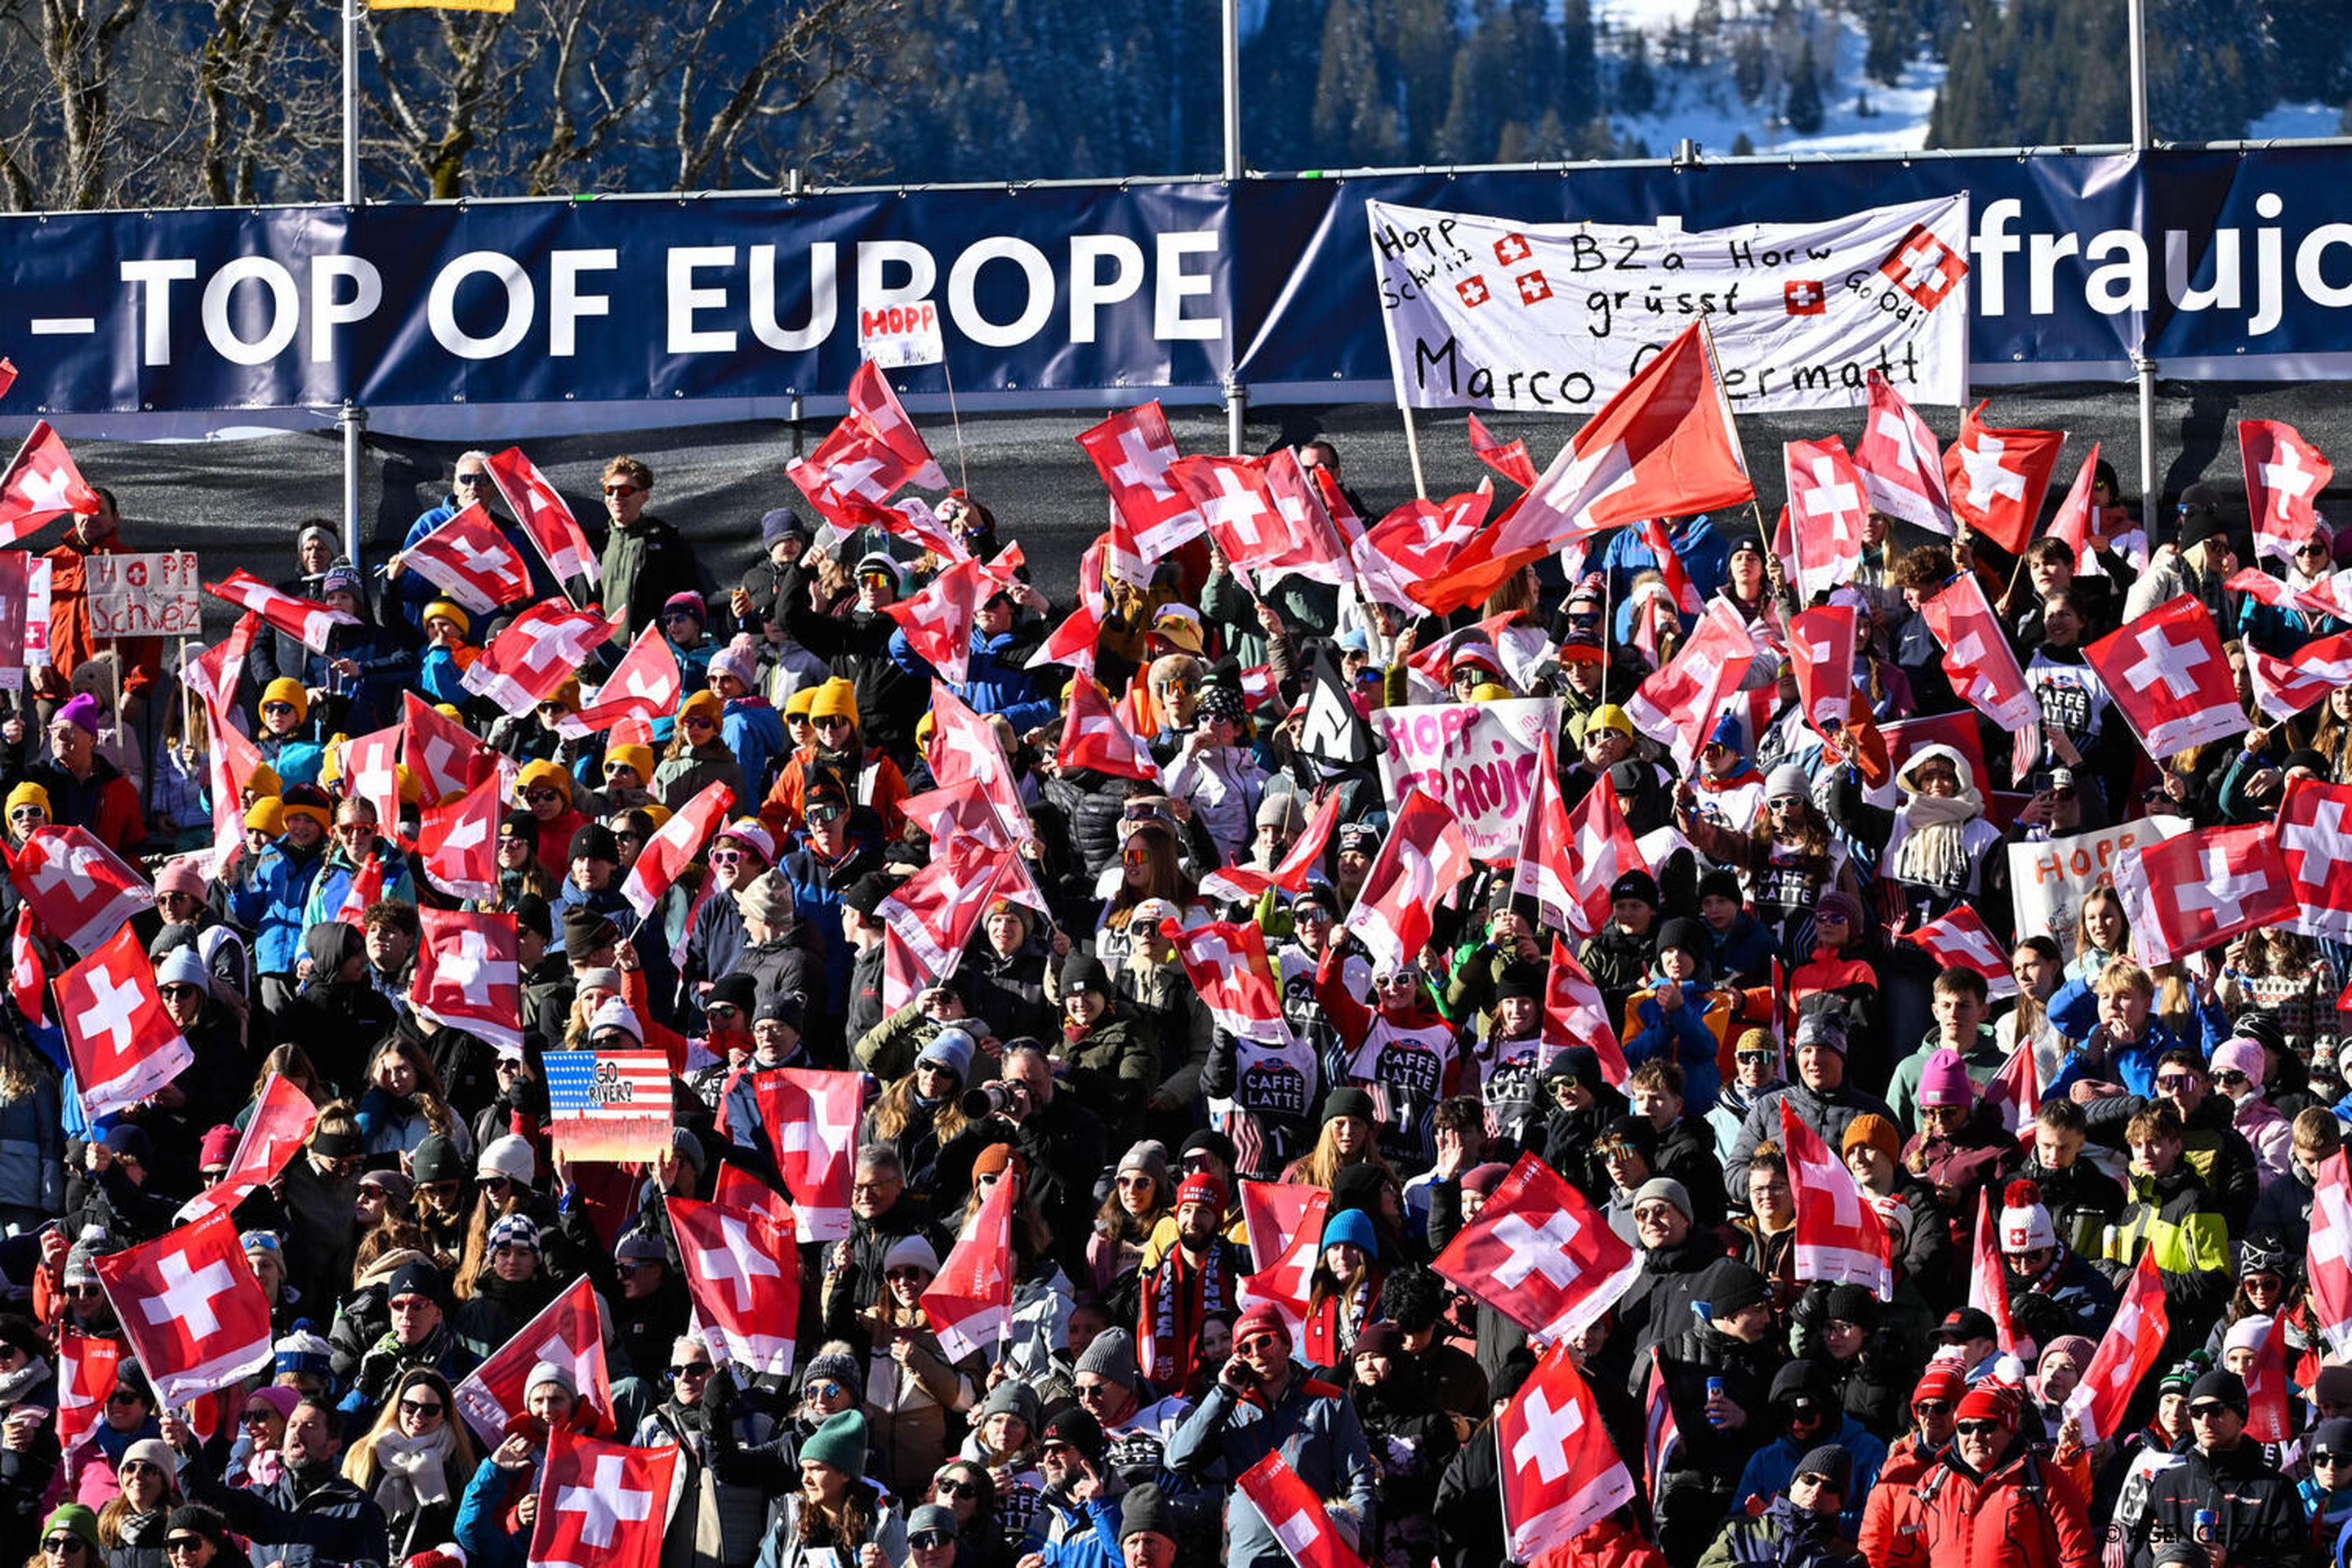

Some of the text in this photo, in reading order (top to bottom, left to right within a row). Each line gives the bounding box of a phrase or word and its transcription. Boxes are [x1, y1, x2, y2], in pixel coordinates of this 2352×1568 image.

[1373, 218, 1457, 262] Hopp
[1729, 240, 1832, 269] Horw
[120, 255, 382, 367] TOP
[428, 248, 618, 360] OF
[667, 230, 1223, 354] EUROPE
[1586, 282, 1739, 338] grüsst
[1845, 270, 1924, 330] Go Odi
[862, 305, 934, 338] HOPP
[1414, 336, 1919, 404] Marco ermatt
[100, 554, 197, 586] HOPP
[2037, 688, 2087, 710] AFFÈ
[1382, 706, 1481, 764] HOPP
[2034, 833, 2136, 885] HOPP
[593, 1062, 617, 1085] GO
[1382, 1067, 1433, 1091] LATTE
[589, 1080, 633, 1103] RIVER!
[1246, 1092, 1302, 1110] LATTE
